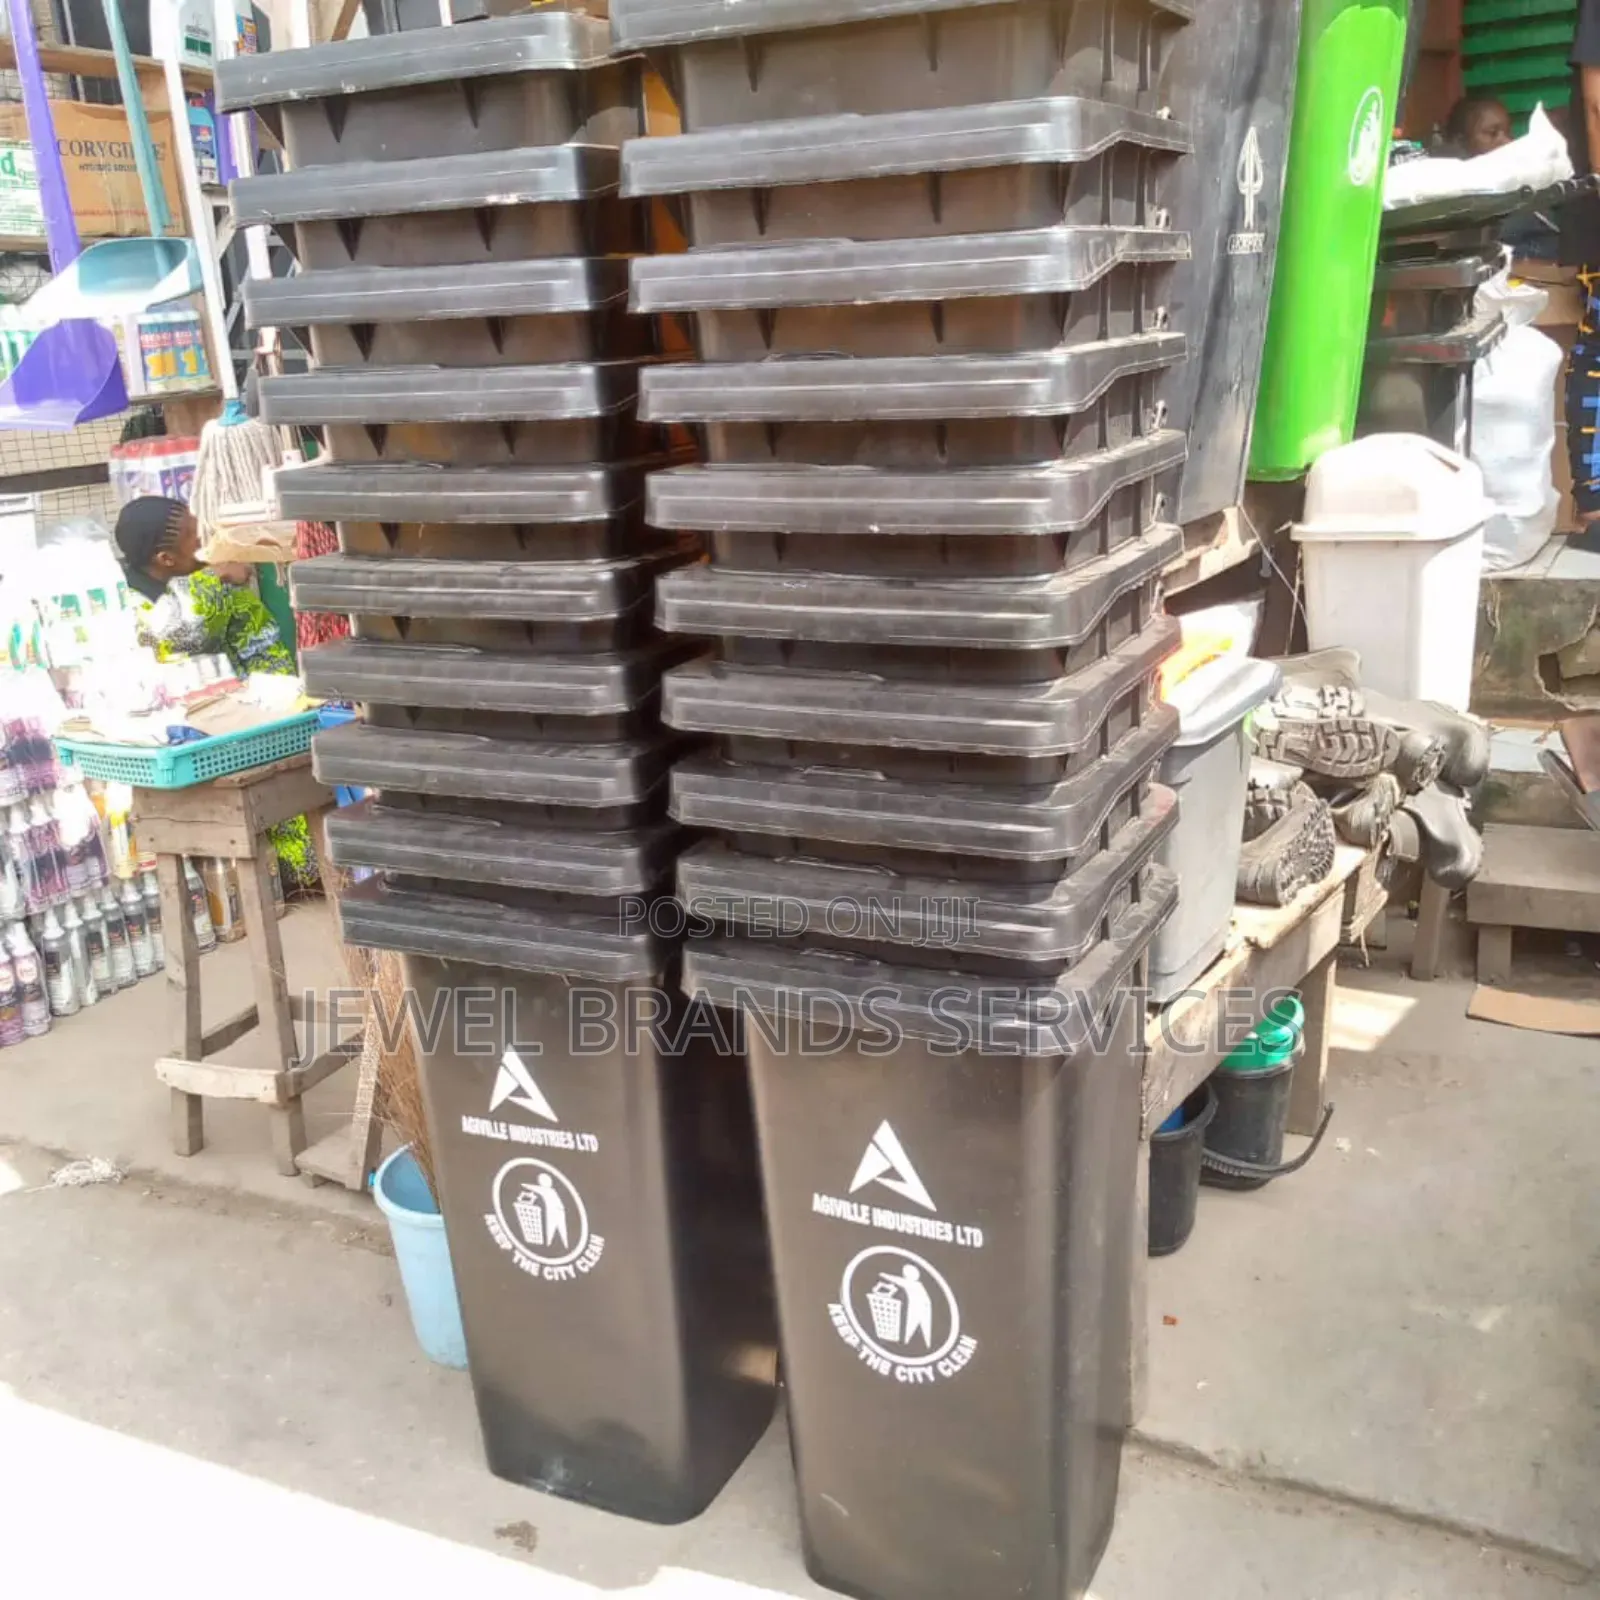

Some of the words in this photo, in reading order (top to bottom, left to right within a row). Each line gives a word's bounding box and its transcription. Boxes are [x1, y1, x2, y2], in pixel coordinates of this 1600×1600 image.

[508, 1123, 576, 1151] INDUSTRIES
[575, 1132, 599, 1153] LTD
[871, 1207, 954, 1243] INDUSTRIES
[955, 1224, 984, 1249] LTD
[512, 1249, 541, 1278] THE
[543, 1263, 577, 1282] CITY
[575, 1233, 606, 1274] CLEAN
[858, 1344, 892, 1377] THE
[894, 1364, 936, 1385] CITY
[936, 1334, 979, 1378] CLEAN
